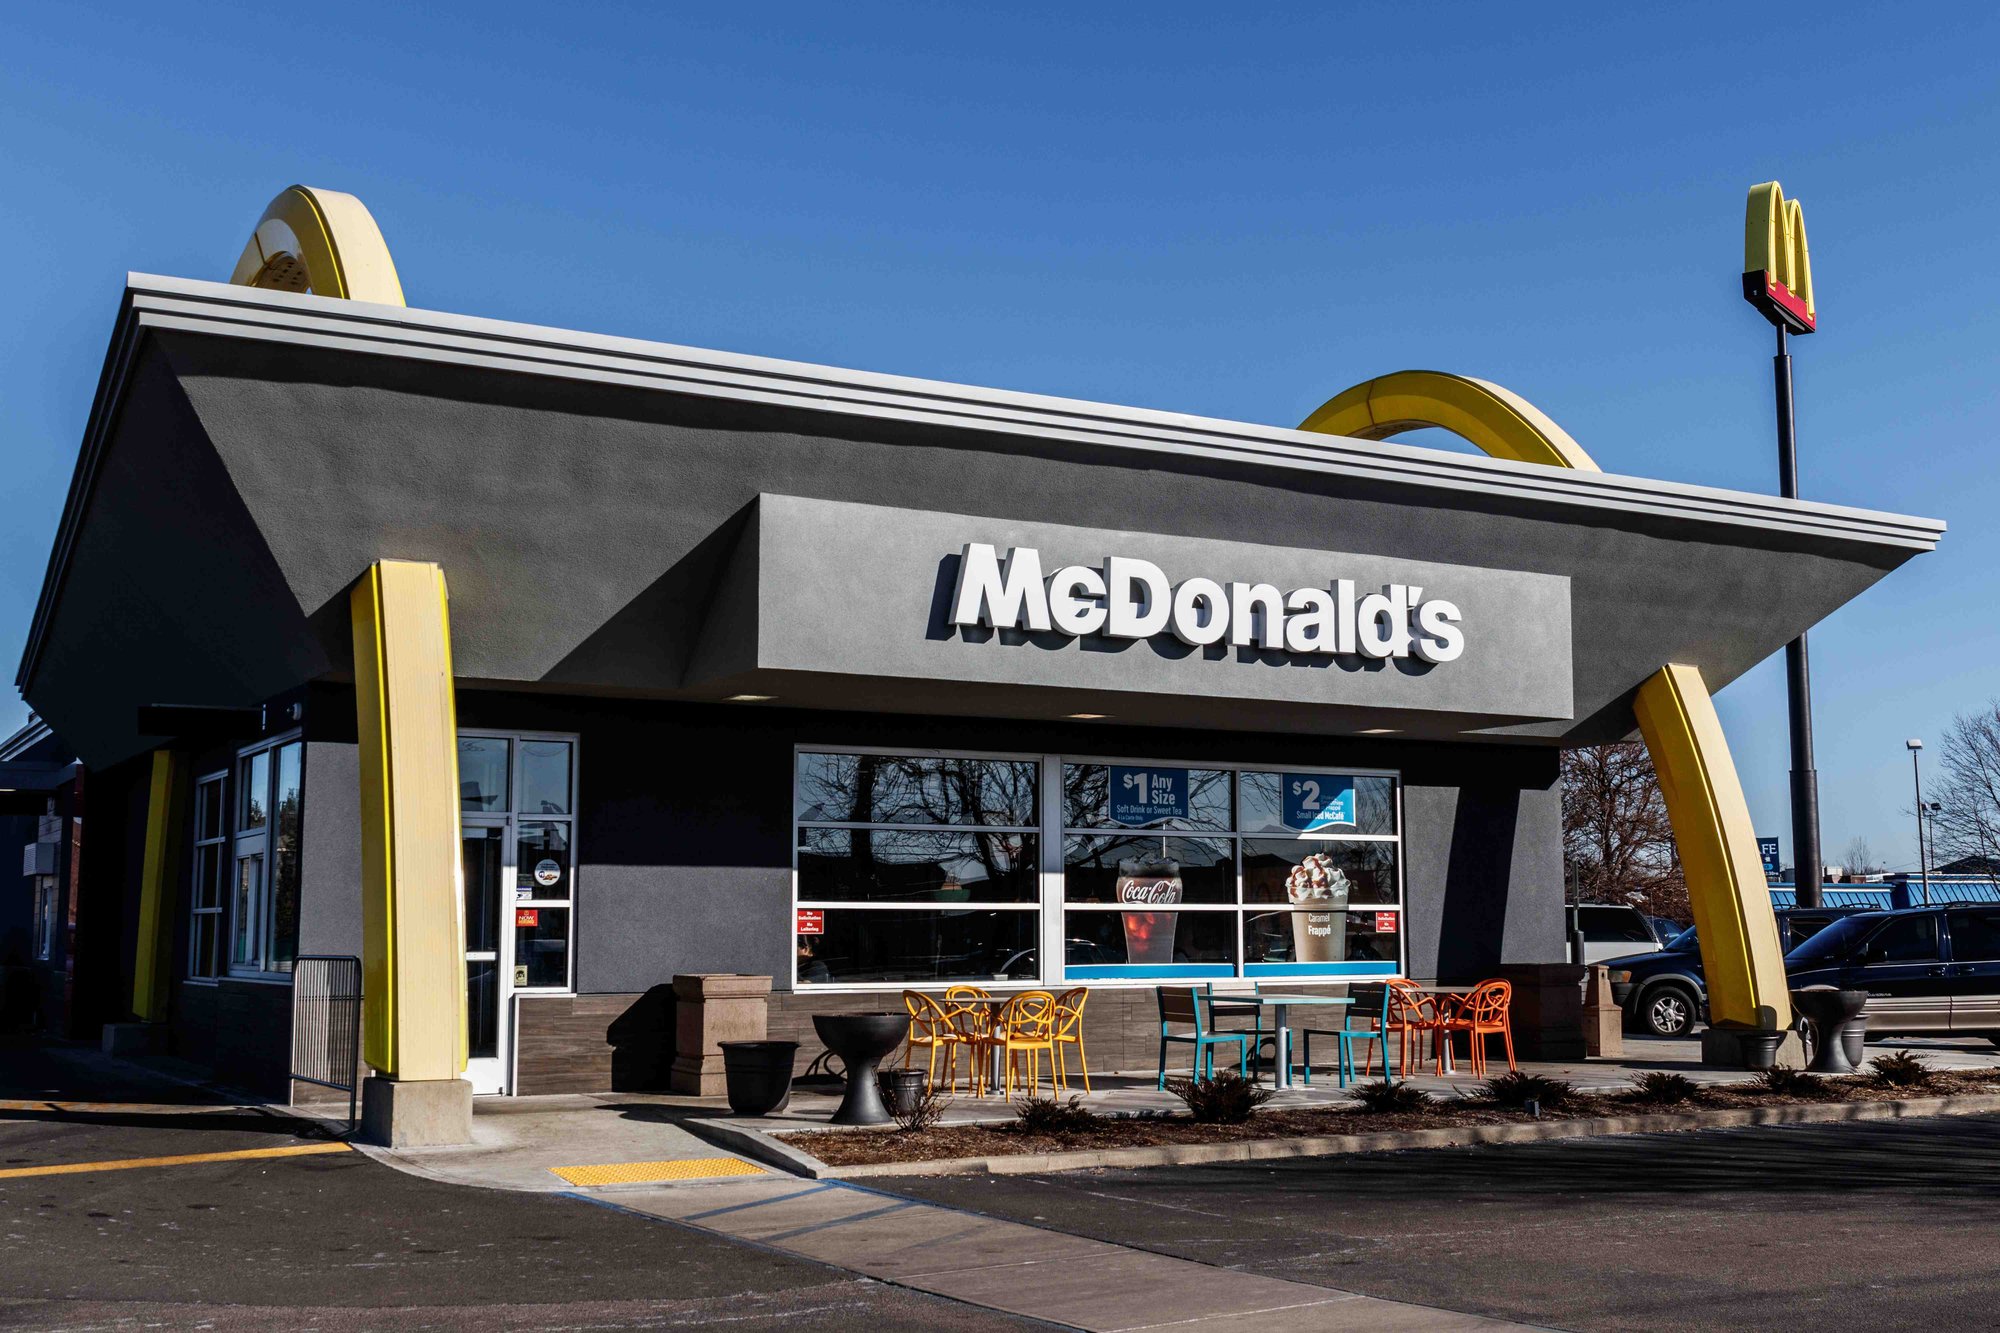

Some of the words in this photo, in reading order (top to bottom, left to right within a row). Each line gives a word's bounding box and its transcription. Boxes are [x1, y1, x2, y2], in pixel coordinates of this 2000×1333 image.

[949, 543, 1464, 663] McDonald's
[1123, 773, 1148, 804] $1
[1152, 774, 1172, 792] Any
[1152, 790, 1176, 805] Size
[1292, 780, 1320, 810] $2
[1117, 804, 1129, 814] Soft
[1130, 805, 1145, 814] Drink
[1153, 805, 1171, 815] Sweet
[1172, 806, 1182, 815] Tea
[1296, 811, 1311, 820] Small
[1313, 811, 1324, 820] Iced
[1324, 811, 1345, 820] McCafé
[1122, 880, 1176, 904] Coca-Cola
[1308, 913, 1330, 923] Caramel
[1308, 925, 1331, 937] Frappé
